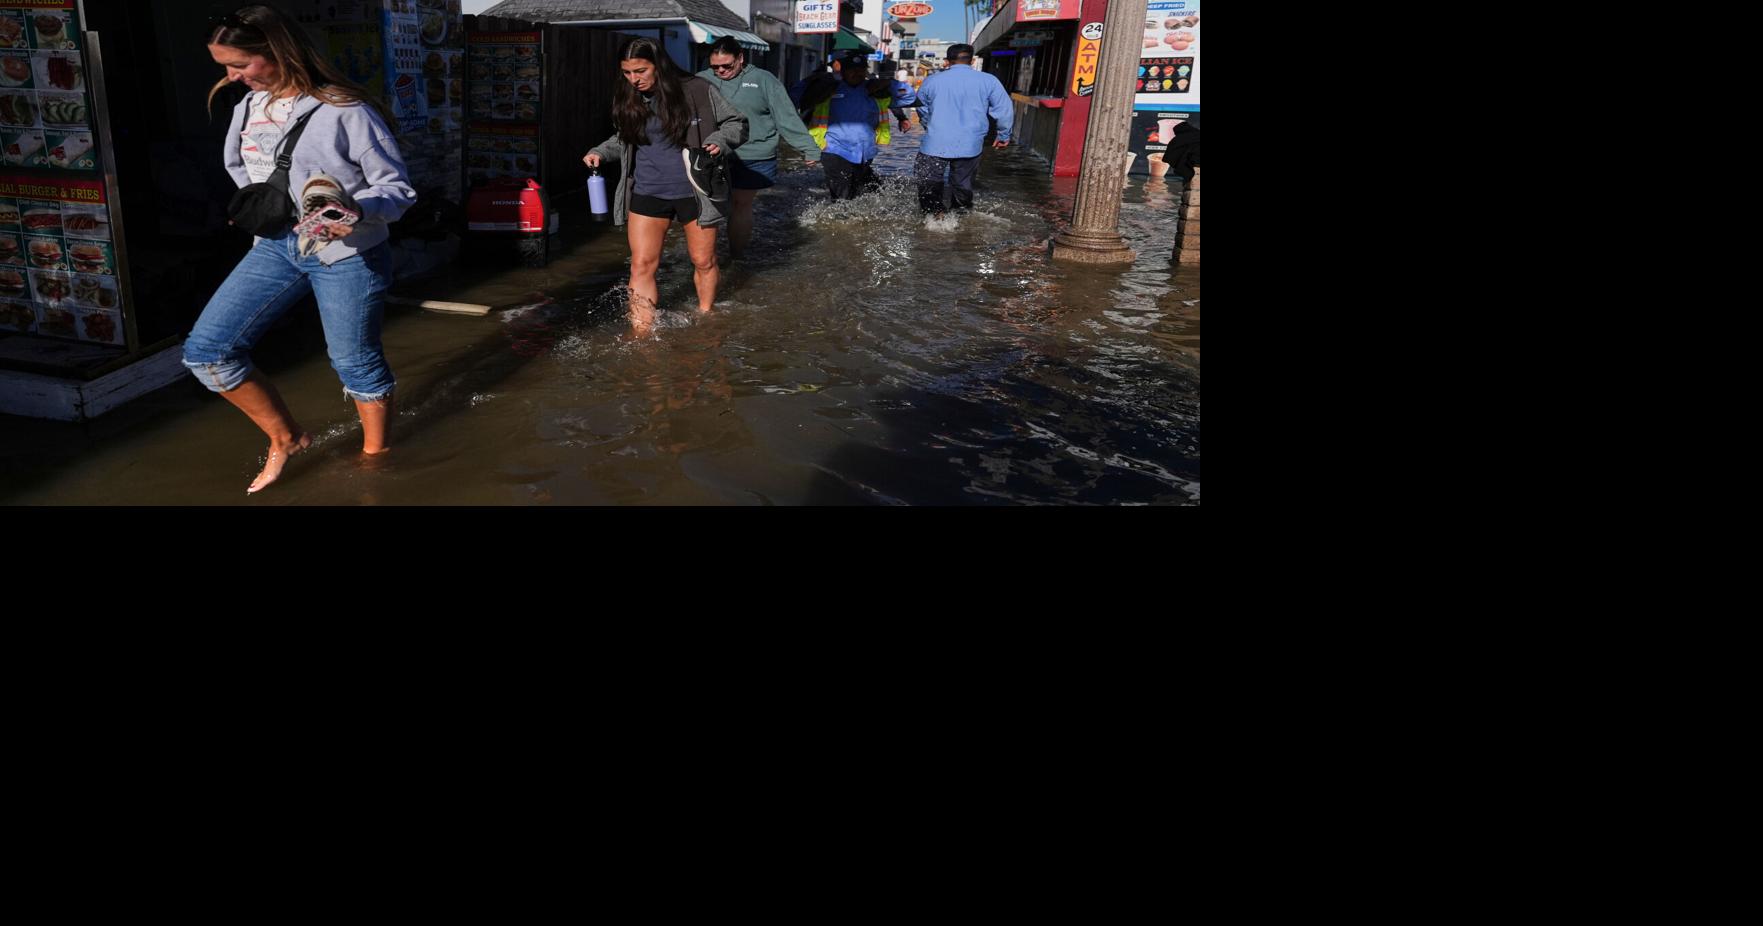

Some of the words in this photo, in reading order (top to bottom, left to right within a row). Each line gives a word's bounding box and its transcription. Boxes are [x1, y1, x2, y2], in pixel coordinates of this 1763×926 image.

[799, 12, 819, 21] BEACH
[798, 21, 836, 29] SUNGLASSES
[1085, 25, 1102, 33] 24
[1078, 42, 1097, 74] ATM
[1172, 57, 1192, 65] ICE
[19, 185, 58, 197] BURGER
[60, 188, 67, 198] &
[70, 188, 99, 200] FRIES
